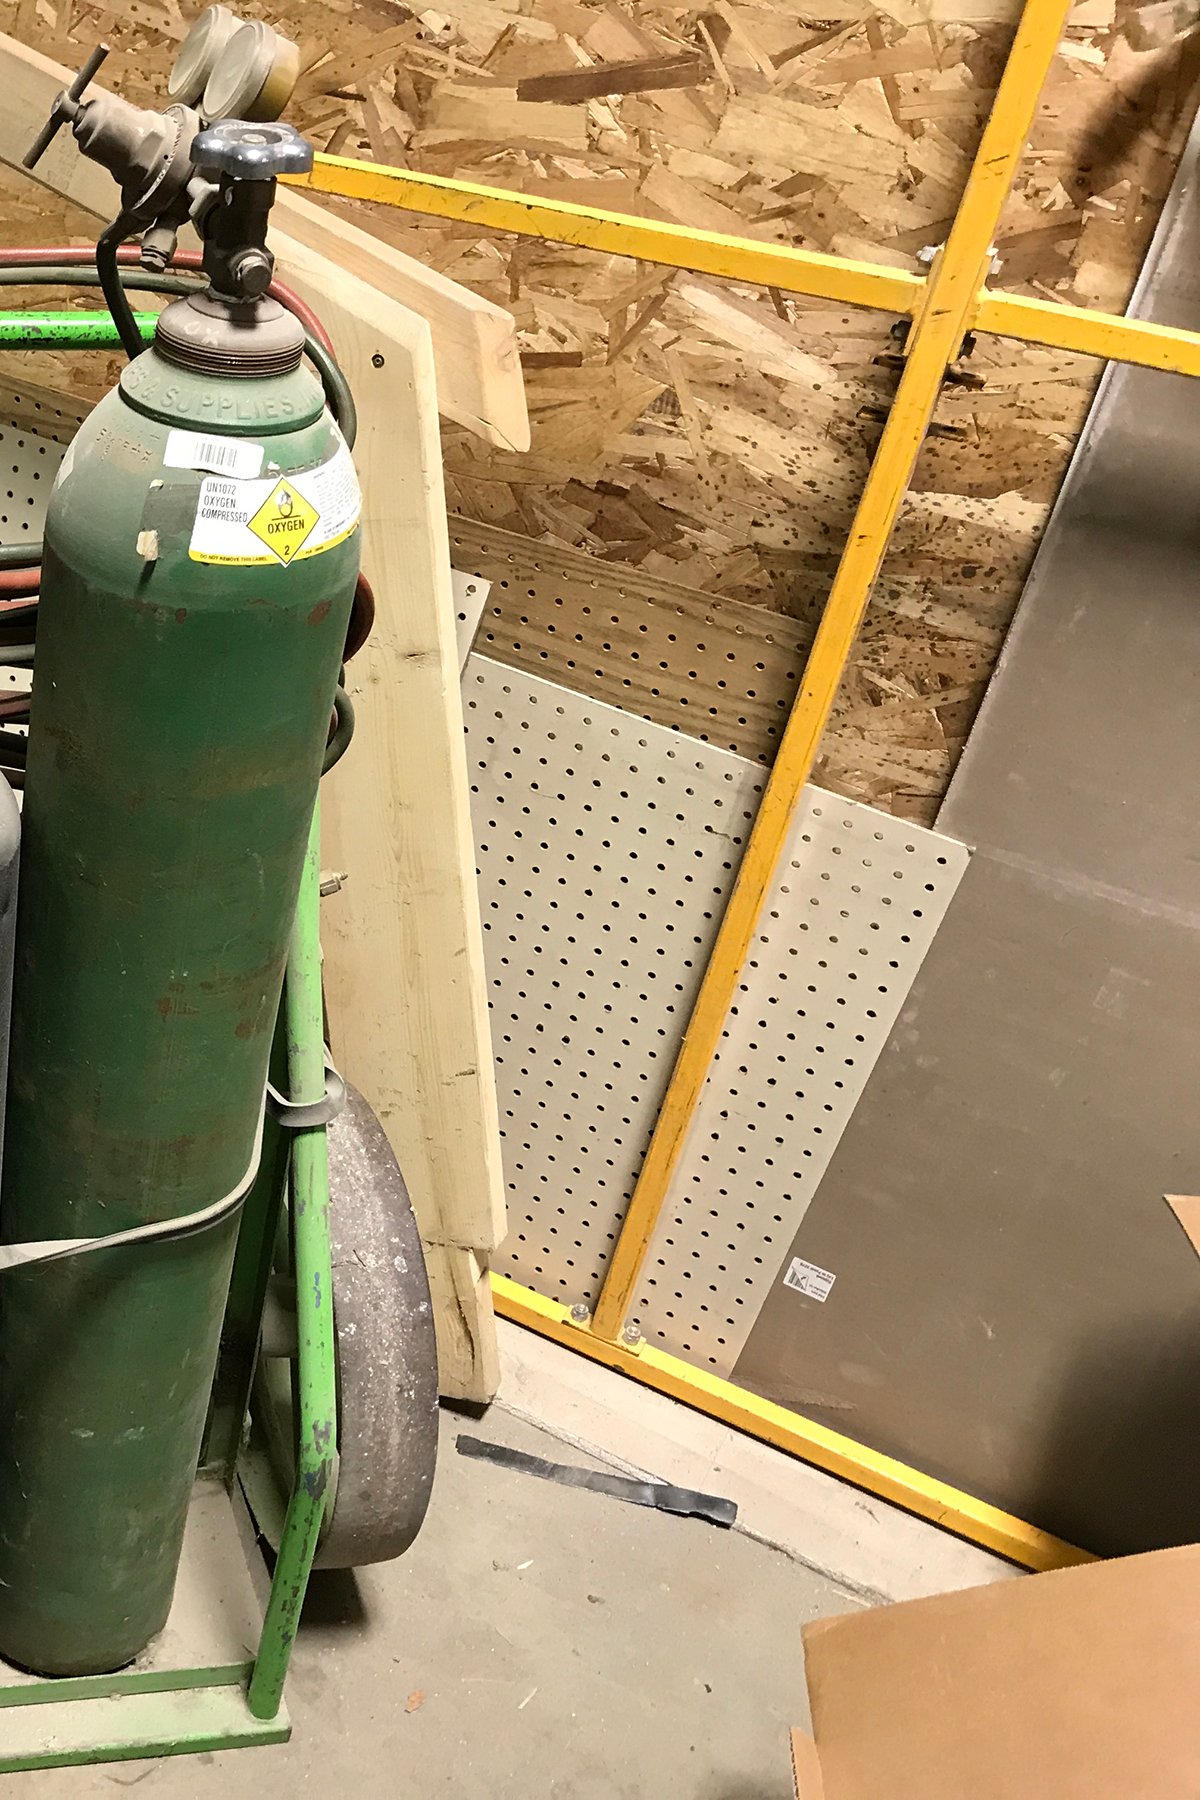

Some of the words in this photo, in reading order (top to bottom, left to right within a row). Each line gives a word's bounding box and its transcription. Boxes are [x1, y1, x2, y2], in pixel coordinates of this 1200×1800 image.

[206, 482, 237, 495] UN1072
[203, 495, 237, 509] OXYGEN
[201, 507, 248, 523] COMPRESSED
[267, 519, 305, 534] OXYGEN
[284, 544, 290, 555] 2
